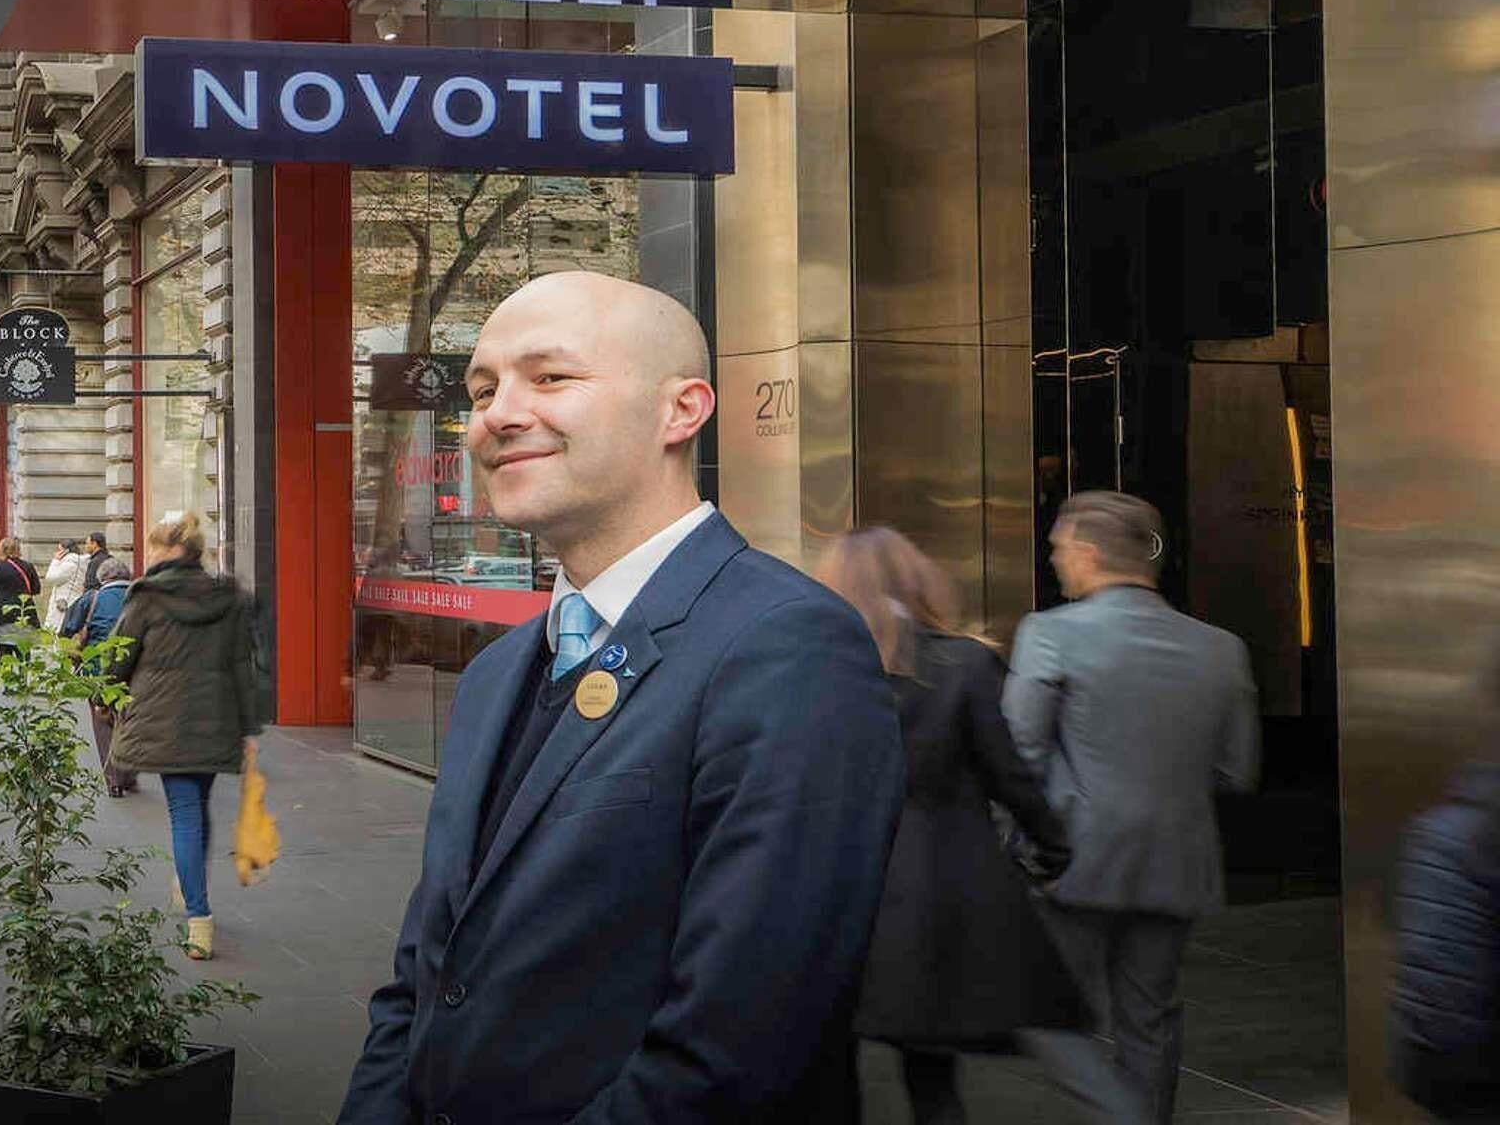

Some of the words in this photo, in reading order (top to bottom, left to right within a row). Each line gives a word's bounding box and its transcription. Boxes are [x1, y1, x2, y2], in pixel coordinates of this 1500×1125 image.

[191, 68, 689, 143] NOVOTEL
[0, 328, 65, 340] BLOCK
[19, 315, 40, 326] The
[755, 378, 796, 421] 270
